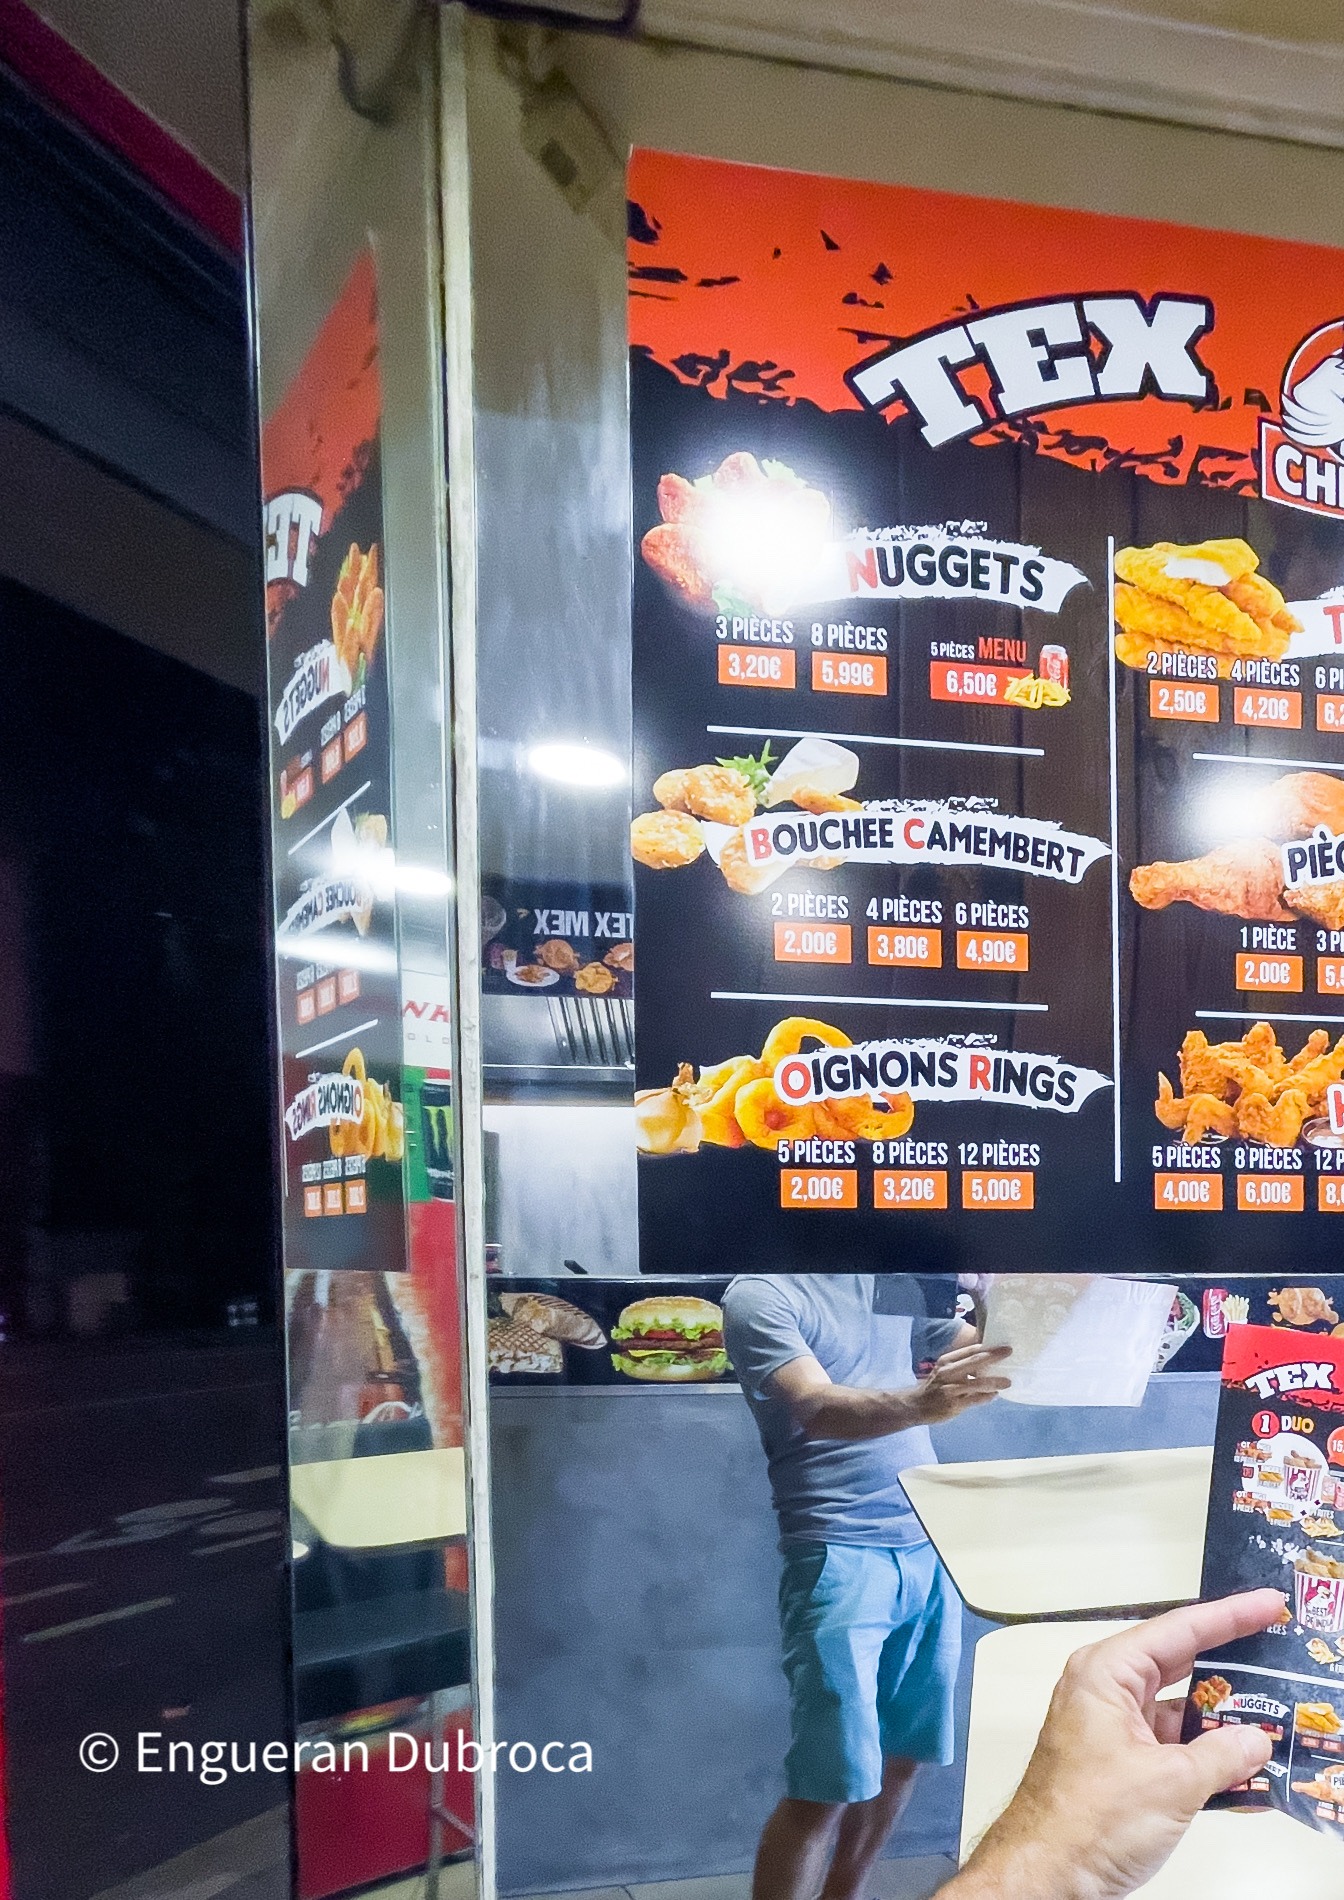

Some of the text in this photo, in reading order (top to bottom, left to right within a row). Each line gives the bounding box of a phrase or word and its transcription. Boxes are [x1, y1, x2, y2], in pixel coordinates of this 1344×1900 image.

[849, 296, 1210, 448] TEX
[846, 544, 1046, 602] NUGGETS
[716, 614, 794, 644] 3 PIÈCES
[811, 620, 888, 652] 8 PIÈCES
[931, 636, 1028, 663] 5 PIÈCES MENU
[728, 652, 782, 681] 3,20€
[821, 659, 874, 688] 5,99€
[1147, 650, 1218, 680] 2 PIÈCES
[1231, 658, 1300, 688] 4 PIÈCES
[1315, 667, 1326, 689] 6
[946, 669, 998, 698] 6,50€
[1158, 687, 1207, 715] 2,50€
[1242, 694, 1290, 722] 4,20€
[751, 815, 1086, 879] BOUCHEE CAMEMBERT
[771, 891, 849, 920] 2 PIÈCES
[866, 894, 942, 923] 4 PIÈCES
[955, 900, 1029, 928] 6 PIÈCES
[784, 929, 837, 956] 2,00€
[877, 932, 928, 960] 3,80€
[965, 937, 1016, 964] 4,90€
[1240, 925, 1296, 951] 1 PIÈCE
[1317, 931, 1327, 952] 3
[1244, 960, 1291, 985] 2,00€
[781, 1051, 1078, 1107] OIGNONS RINGS
[778, 1137, 856, 1165] 5 PIÈCES
[872, 1139, 949, 1166] 8 PIÈCES
[958, 1140, 1041, 1168] 12 PIÈCES
[1152, 1144, 1221, 1170] 5 PIÈCES
[1235, 1145, 1302, 1171] 8 PIÈCES
[1314, 1149, 1331, 1169] 12
[791, 1175, 843, 1201] 2,00€
[883, 1176, 935, 1202] 3,20€
[971, 1177, 1021, 1203] 5,00€
[1162, 1179, 1210, 1204] 4,00€
[1245, 1180, 1291, 1205] 6,00€
[1245, 1362, 1335, 1400] TEX
[1260, 1415, 1314, 1434] 1 DUO
[1233, 1698, 1280, 1715] NUGGETS
